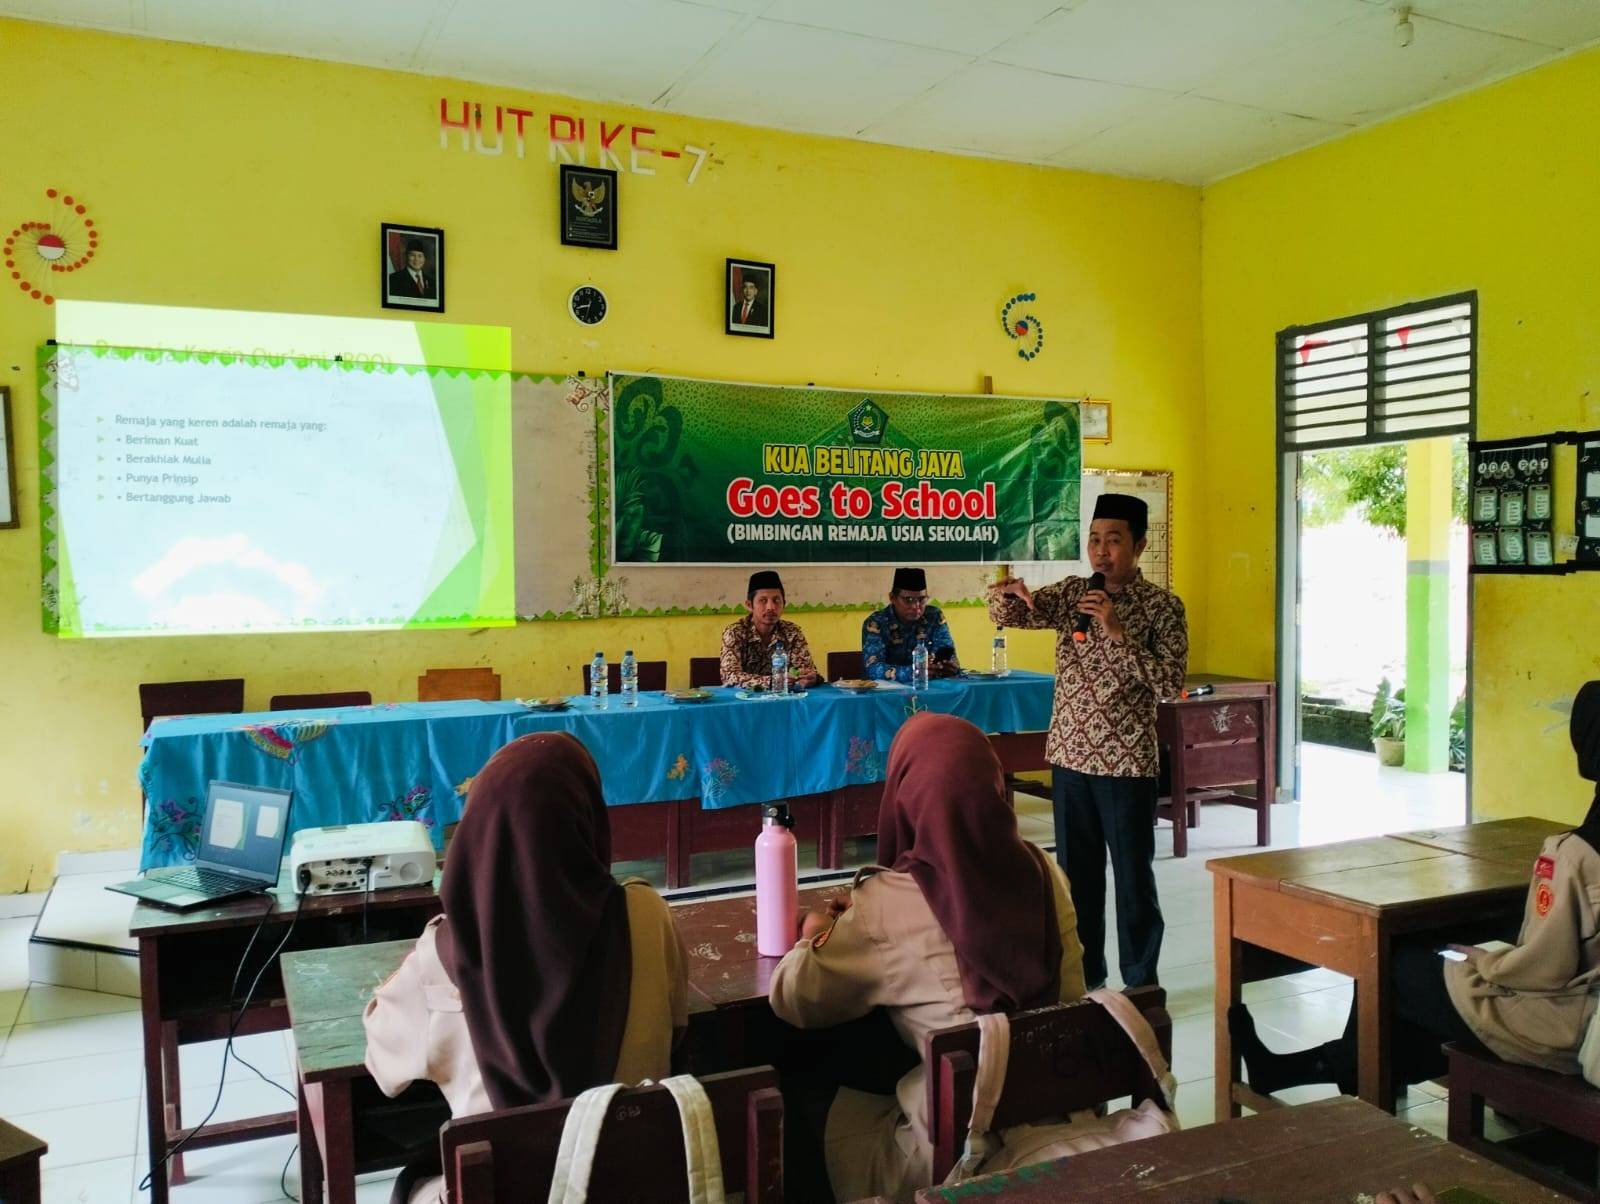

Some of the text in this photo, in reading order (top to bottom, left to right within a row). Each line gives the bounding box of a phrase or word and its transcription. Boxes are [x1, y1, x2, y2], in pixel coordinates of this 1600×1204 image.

[440, 97, 533, 159] HUT
[549, 113, 586, 167] RI
[115, 415, 328, 432] Remaja yang keren adalah remaja yang:
[125, 434, 199, 446] Beriman Kuat
[125, 453, 212, 465] Berakhlak Mulia
[763, 443, 965, 479] KUA BELITANG JAYA
[125, 473, 199, 486] Punya Prinsip
[125, 492, 231, 505] Bertanggung Jawab
[726, 477, 996, 520] Goes to School
[727, 522, 999, 545] (BIMBINGAN REMAJA USIA SEKOLAH)
